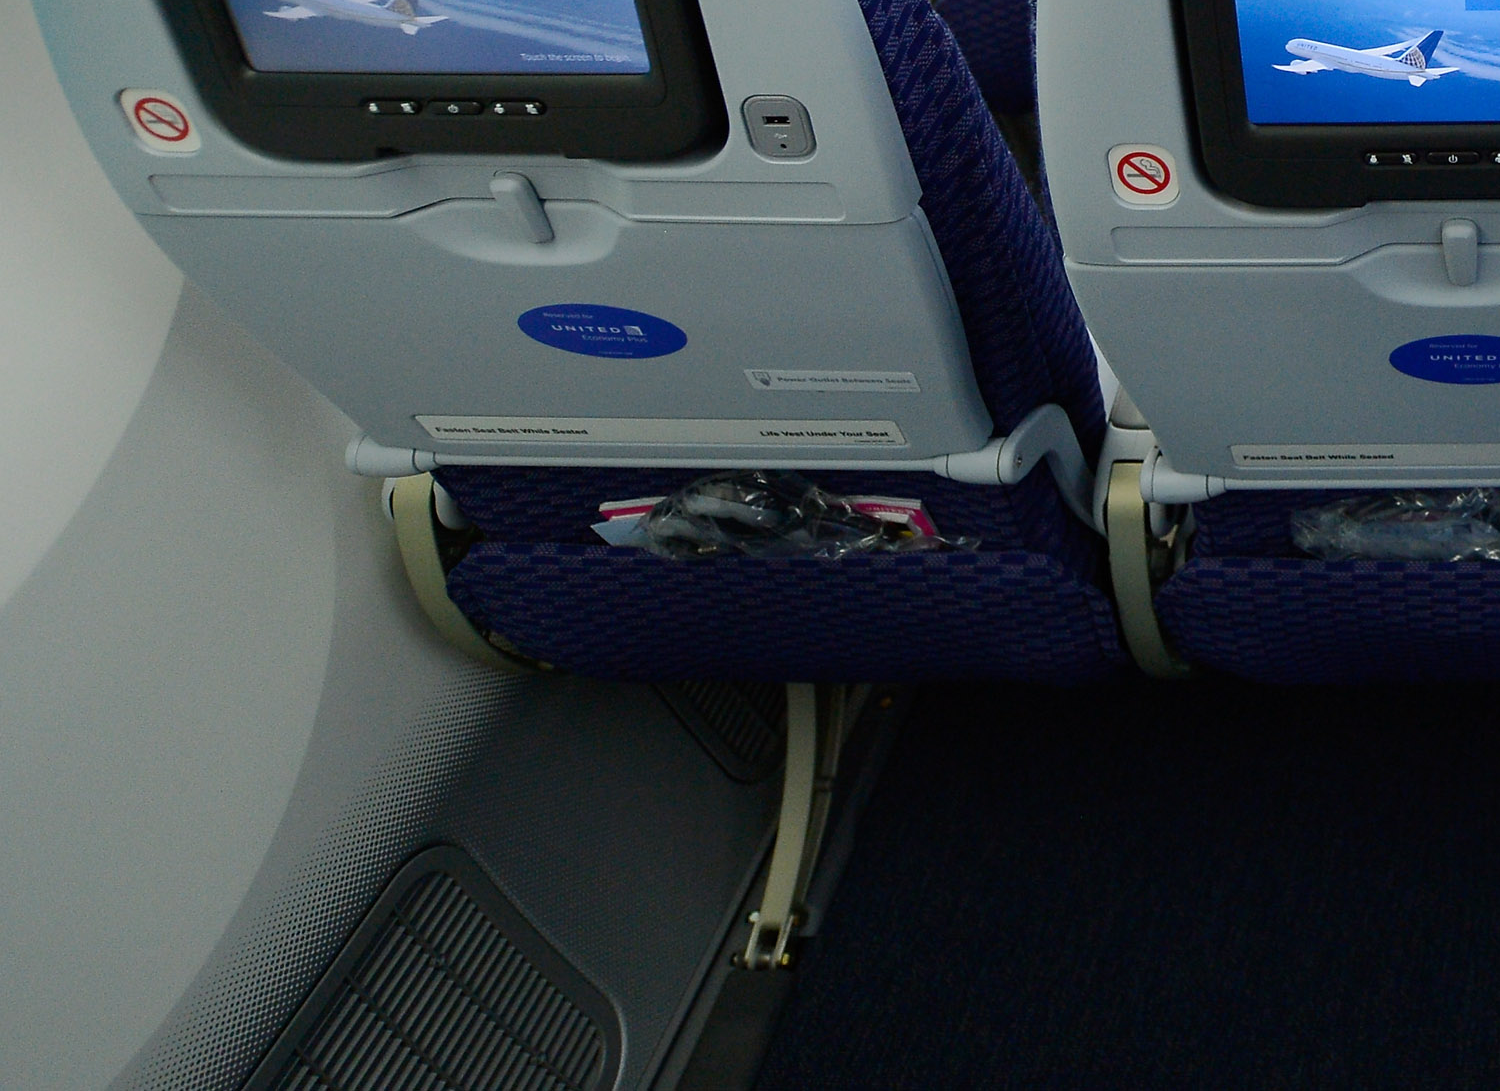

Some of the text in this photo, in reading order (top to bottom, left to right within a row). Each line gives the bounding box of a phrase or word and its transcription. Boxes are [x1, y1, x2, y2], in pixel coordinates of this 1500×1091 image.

[1296, 42, 1318, 51] UNITED
[551, 324, 621, 334] UNITED
[581, 334, 625, 343] Economy
[806, 430, 837, 438] Under
